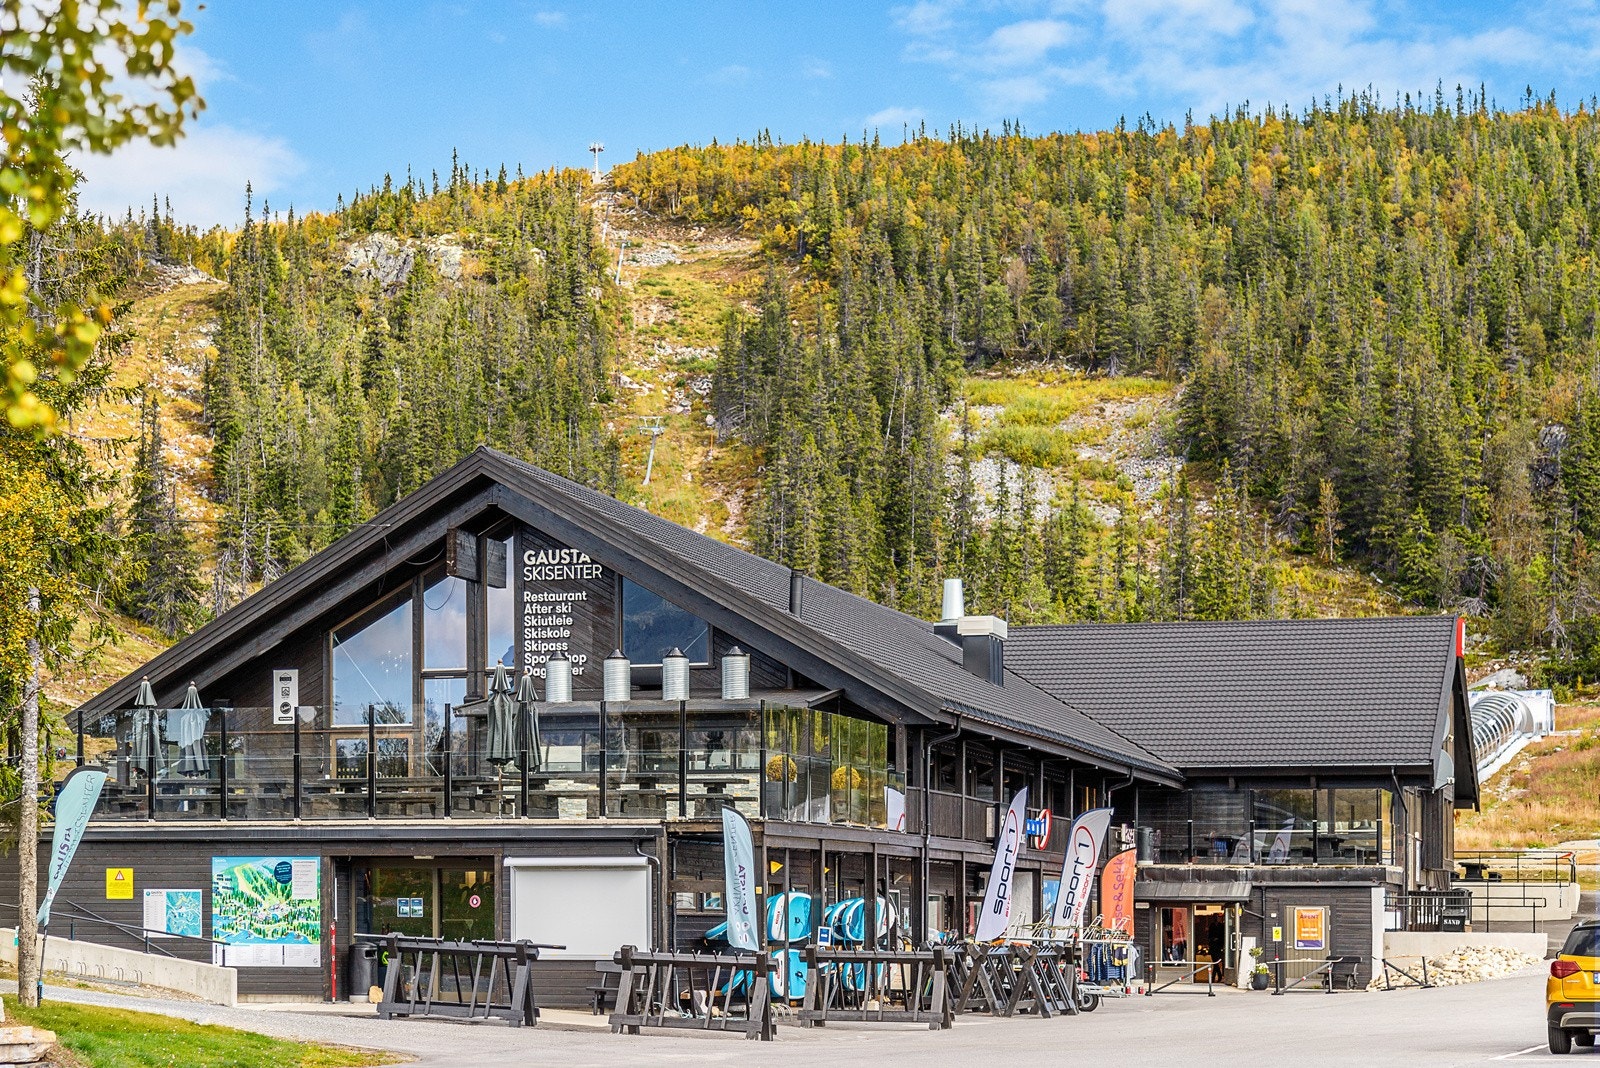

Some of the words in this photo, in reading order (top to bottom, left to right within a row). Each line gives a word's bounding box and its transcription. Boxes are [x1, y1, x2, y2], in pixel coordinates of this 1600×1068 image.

[523, 549, 591, 565] GAUSTA
[523, 565, 602, 581] SKISENTER
[523, 591, 587, 602] Restaurant
[524, 603, 553, 614] After
[555, 603, 572, 613] ski
[524, 615, 573, 627] Skiutleie
[524, 628, 571, 639] Skiskole
[524, 640, 568, 654] Skipass
[524, 652, 587, 666] Sporhop
[524, 665, 585, 679] Dager
[993, 844, 1013, 915] sport
[1113, 857, 1125, 890] Sekk
[1063, 856, 1084, 920] sport
[1113, 892, 1124, 901] &
